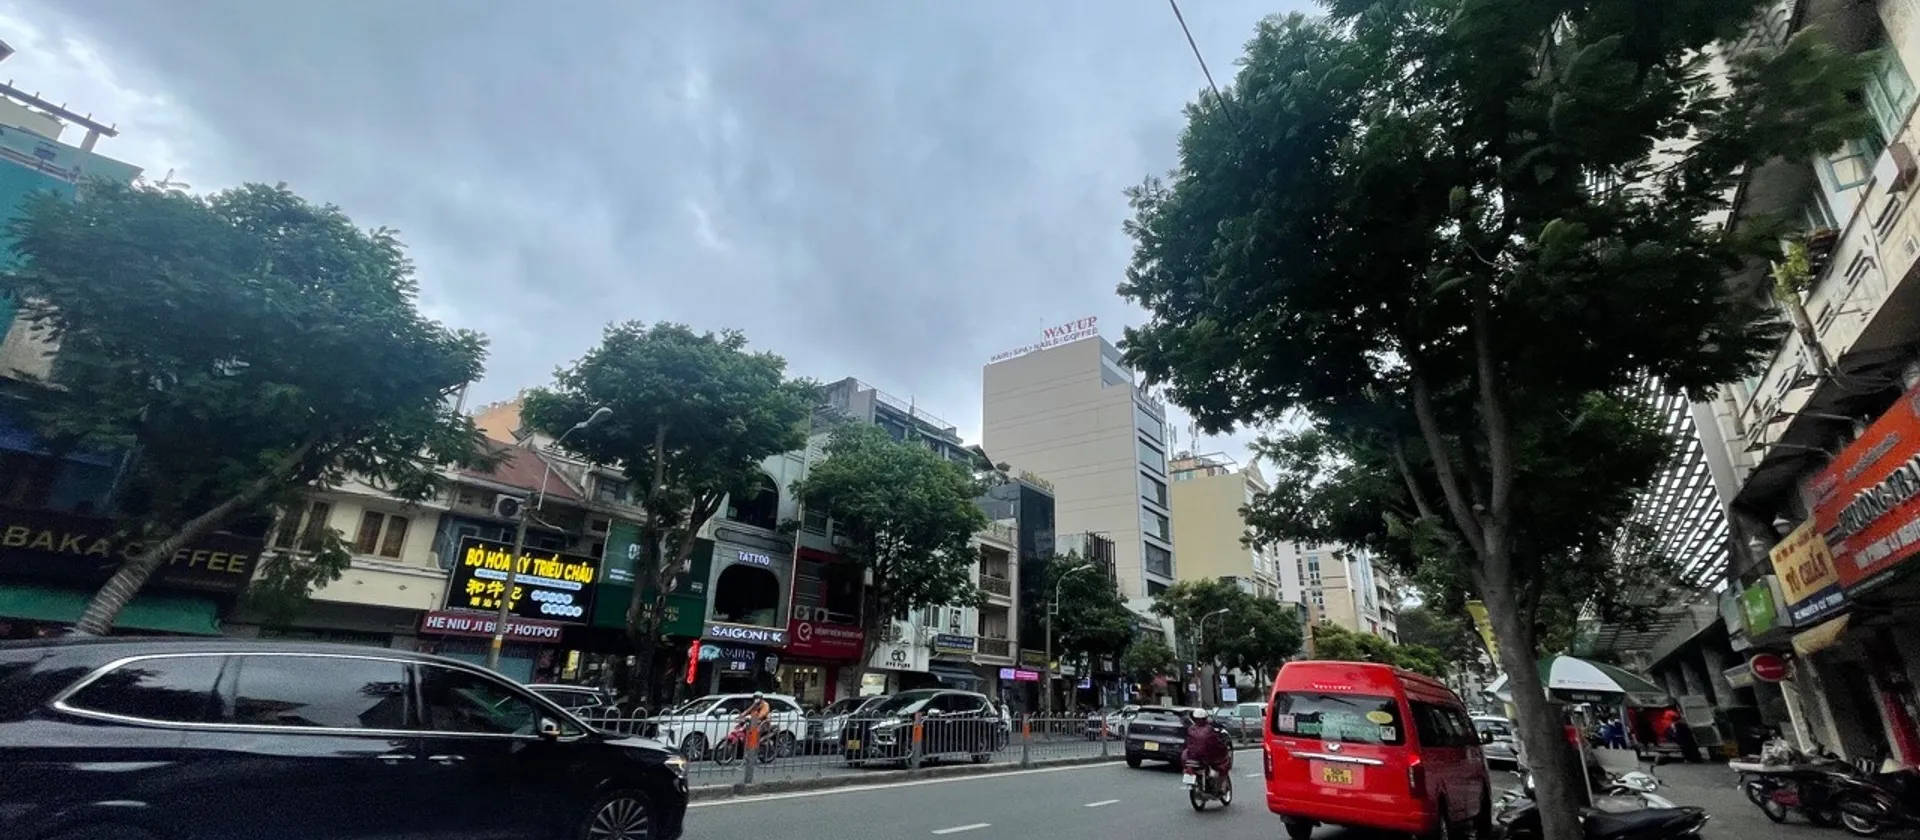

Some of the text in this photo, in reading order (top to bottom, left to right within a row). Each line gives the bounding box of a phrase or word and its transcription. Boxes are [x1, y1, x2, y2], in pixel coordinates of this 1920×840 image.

[1044, 316, 1098, 340] WAY UP
[1063, 327, 1098, 342] COFFEE
[2, 525, 249, 573] BAKA CFFEE
[739, 551, 769, 565] TATTOO
[426, 616, 445, 628] HE
[446, 618, 471, 630] NIU
[471, 621, 482, 632] JI
[514, 624, 560, 638] HOTPOT
[711, 626, 782, 642] SAIGONIK
